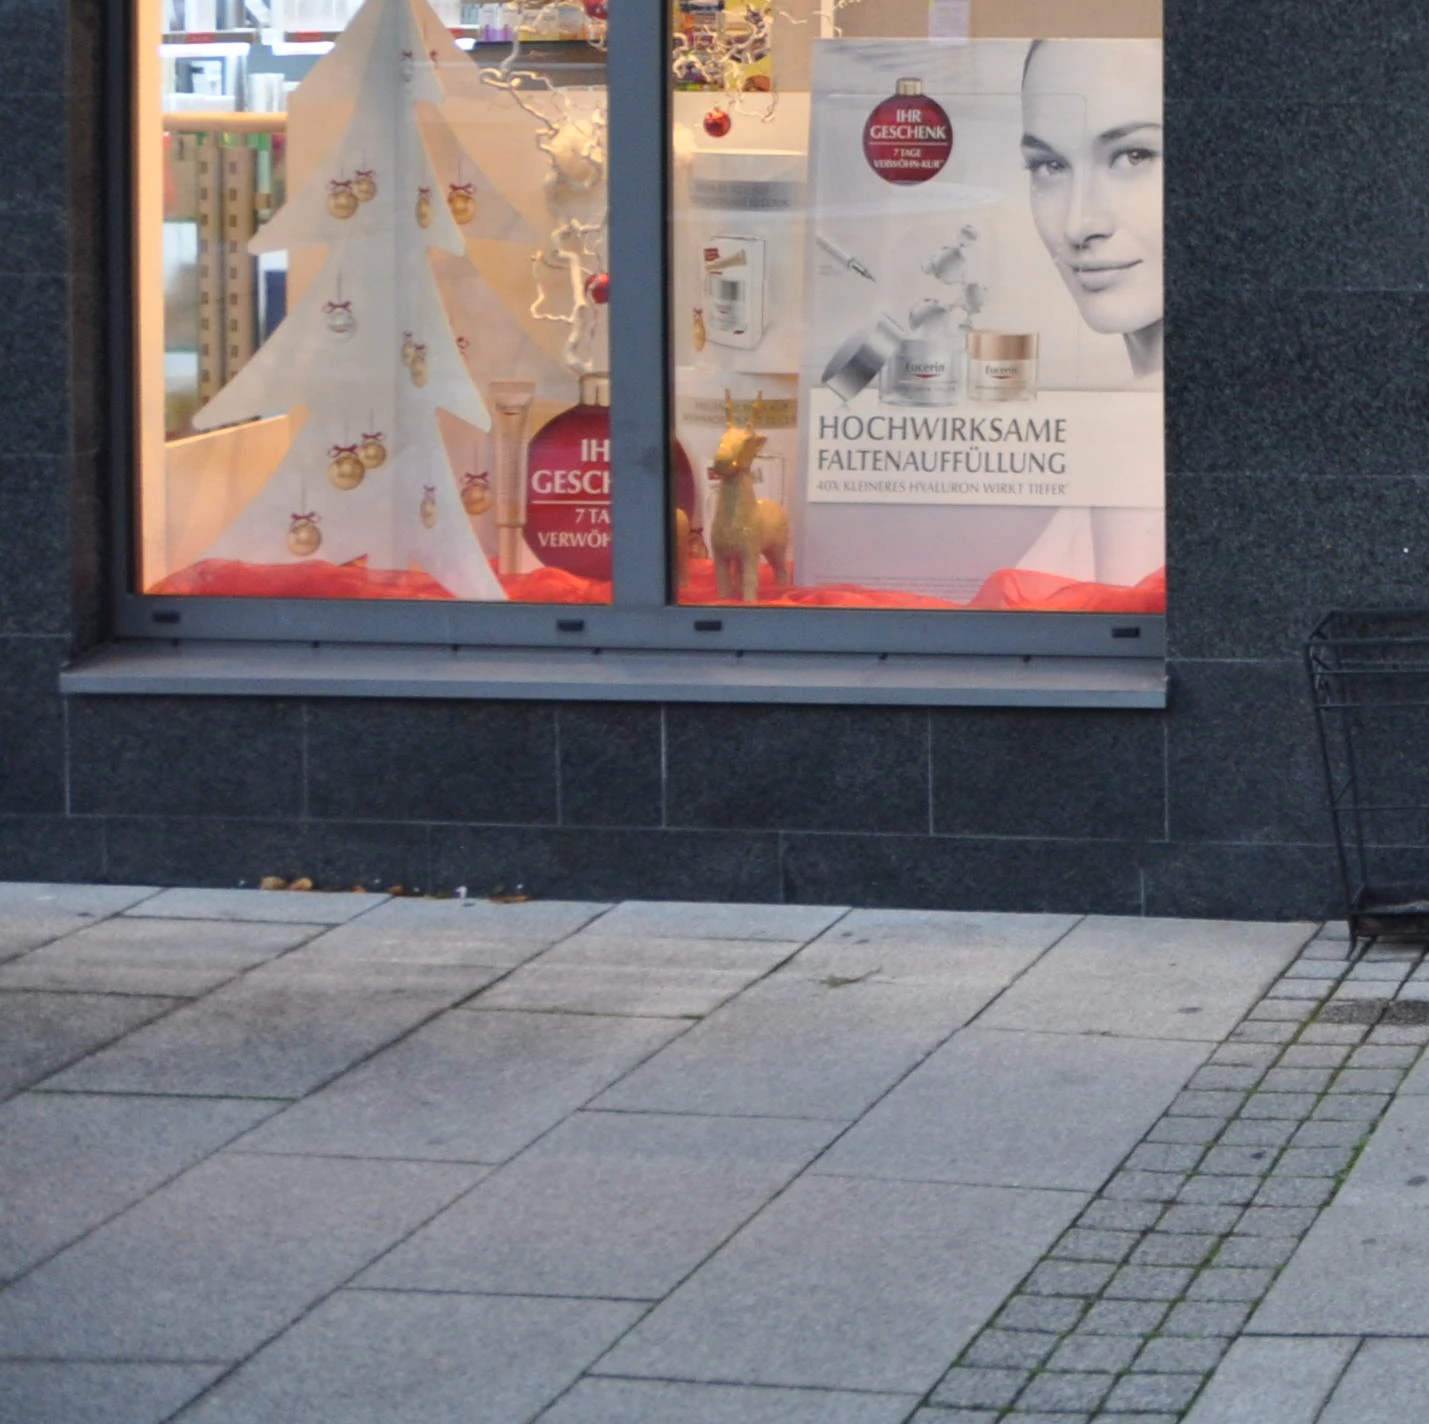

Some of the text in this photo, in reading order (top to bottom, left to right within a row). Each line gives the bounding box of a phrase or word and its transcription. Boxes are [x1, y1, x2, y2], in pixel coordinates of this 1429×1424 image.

[895, 108, 922, 123] IHR
[869, 124, 947, 140] GESCHENK
[905, 361, 945, 373] Eucerin
[818, 415, 1067, 444] HOCHWIRKSAME
[580, 438, 611, 463] IH
[817, 446, 1067, 474] FALTENAUFFÜLLUNG
[815, 479, 842, 493] 40X
[843, 480, 906, 494] KLEINERES
[908, 480, 980, 495] HYALURON
[982, 482, 1024, 495] WIRKT
[574, 508, 585, 524] 7
